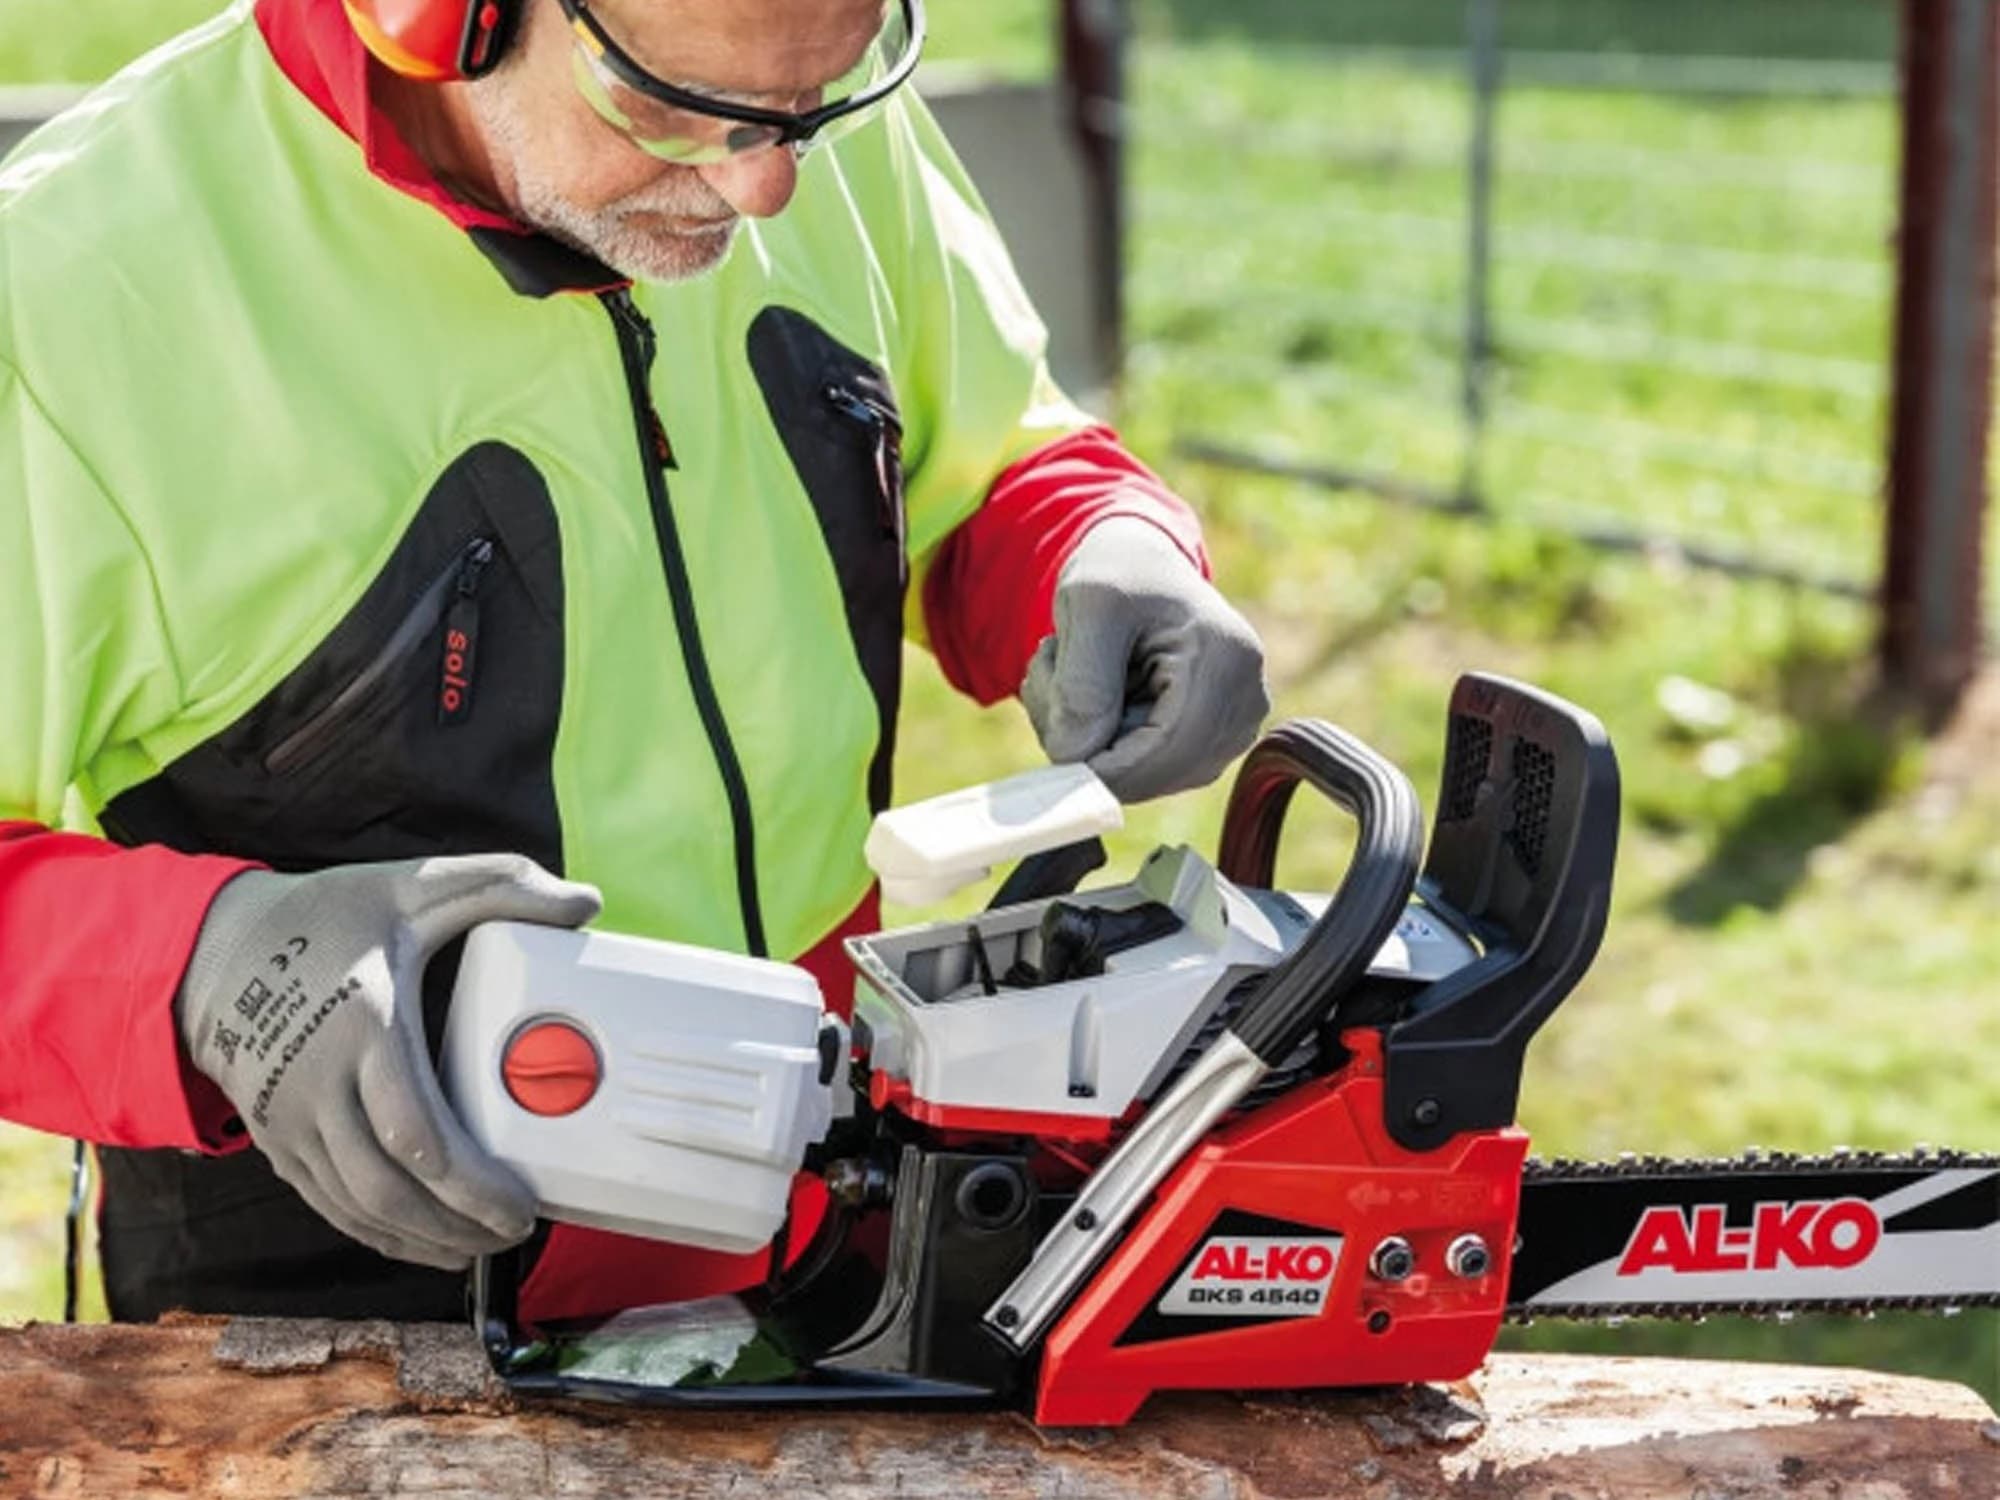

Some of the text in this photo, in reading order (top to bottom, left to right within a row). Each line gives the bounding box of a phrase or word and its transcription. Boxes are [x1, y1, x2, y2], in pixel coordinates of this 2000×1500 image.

[443, 629, 468, 712] solo
[252, 977, 362, 1128] Honeywell
[1190, 1245, 1334, 1283] AL-KO
[1616, 1199, 1881, 1277] AL-KO
[1187, 1287, 1321, 1305] BKS 4540
